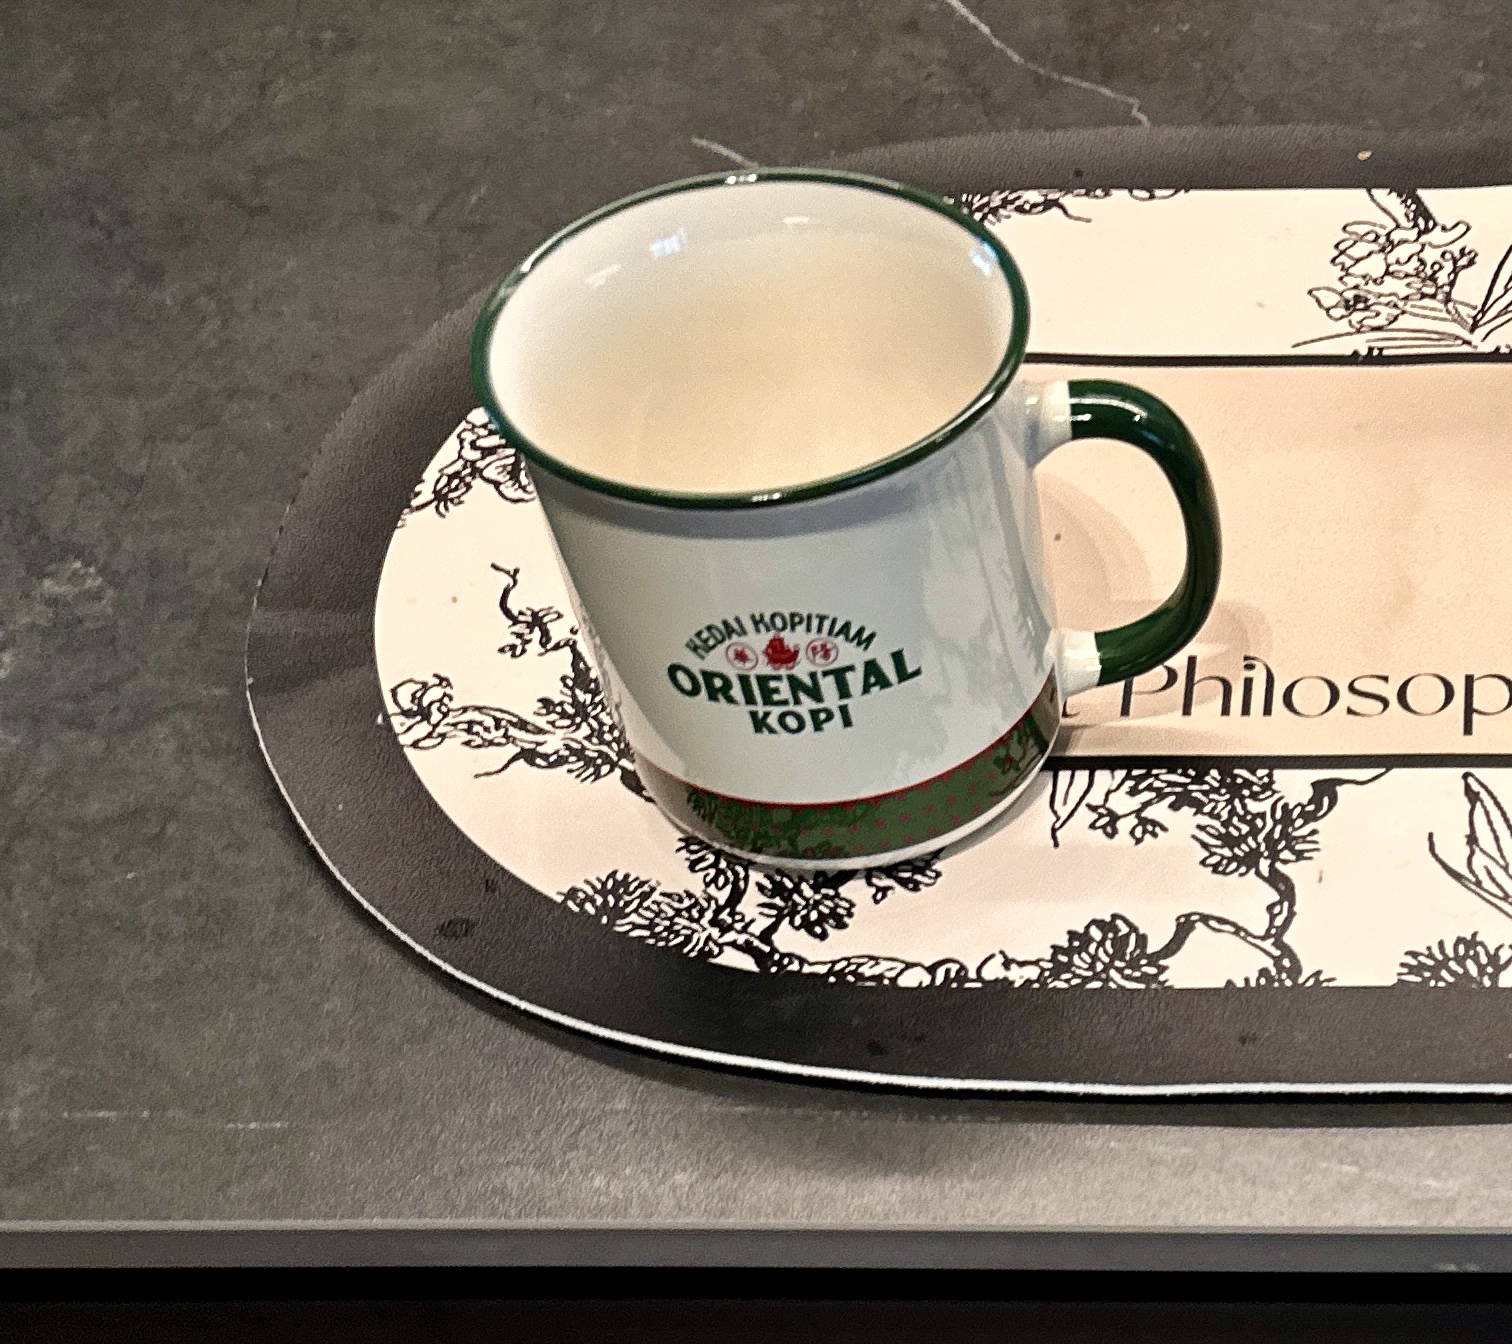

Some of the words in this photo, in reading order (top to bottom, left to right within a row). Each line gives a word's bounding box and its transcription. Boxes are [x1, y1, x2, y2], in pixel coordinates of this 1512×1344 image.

[684, 615, 747, 661] KEDAI
[750, 611, 878, 652] KOPITIAM
[666, 647, 923, 708] ORIENTAL
[748, 702, 854, 736] KOPI
